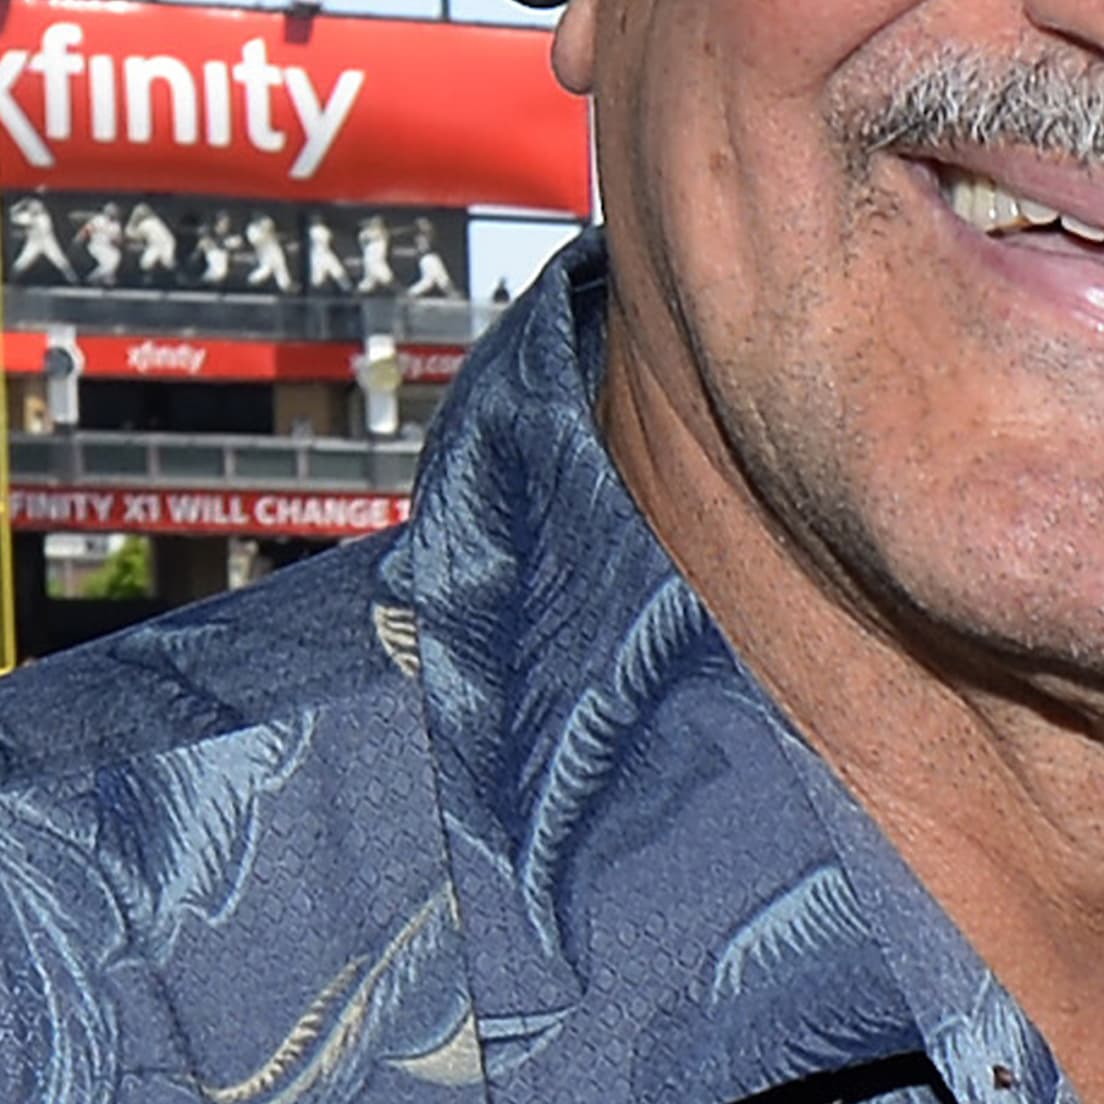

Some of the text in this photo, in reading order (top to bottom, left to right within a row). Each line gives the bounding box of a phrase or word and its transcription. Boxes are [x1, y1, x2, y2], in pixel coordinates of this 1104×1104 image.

[127, 339, 207, 375] xfinity
[122, 494, 161, 524] X1
[166, 495, 247, 525] WILL
[254, 496, 390, 528] CHANGE
